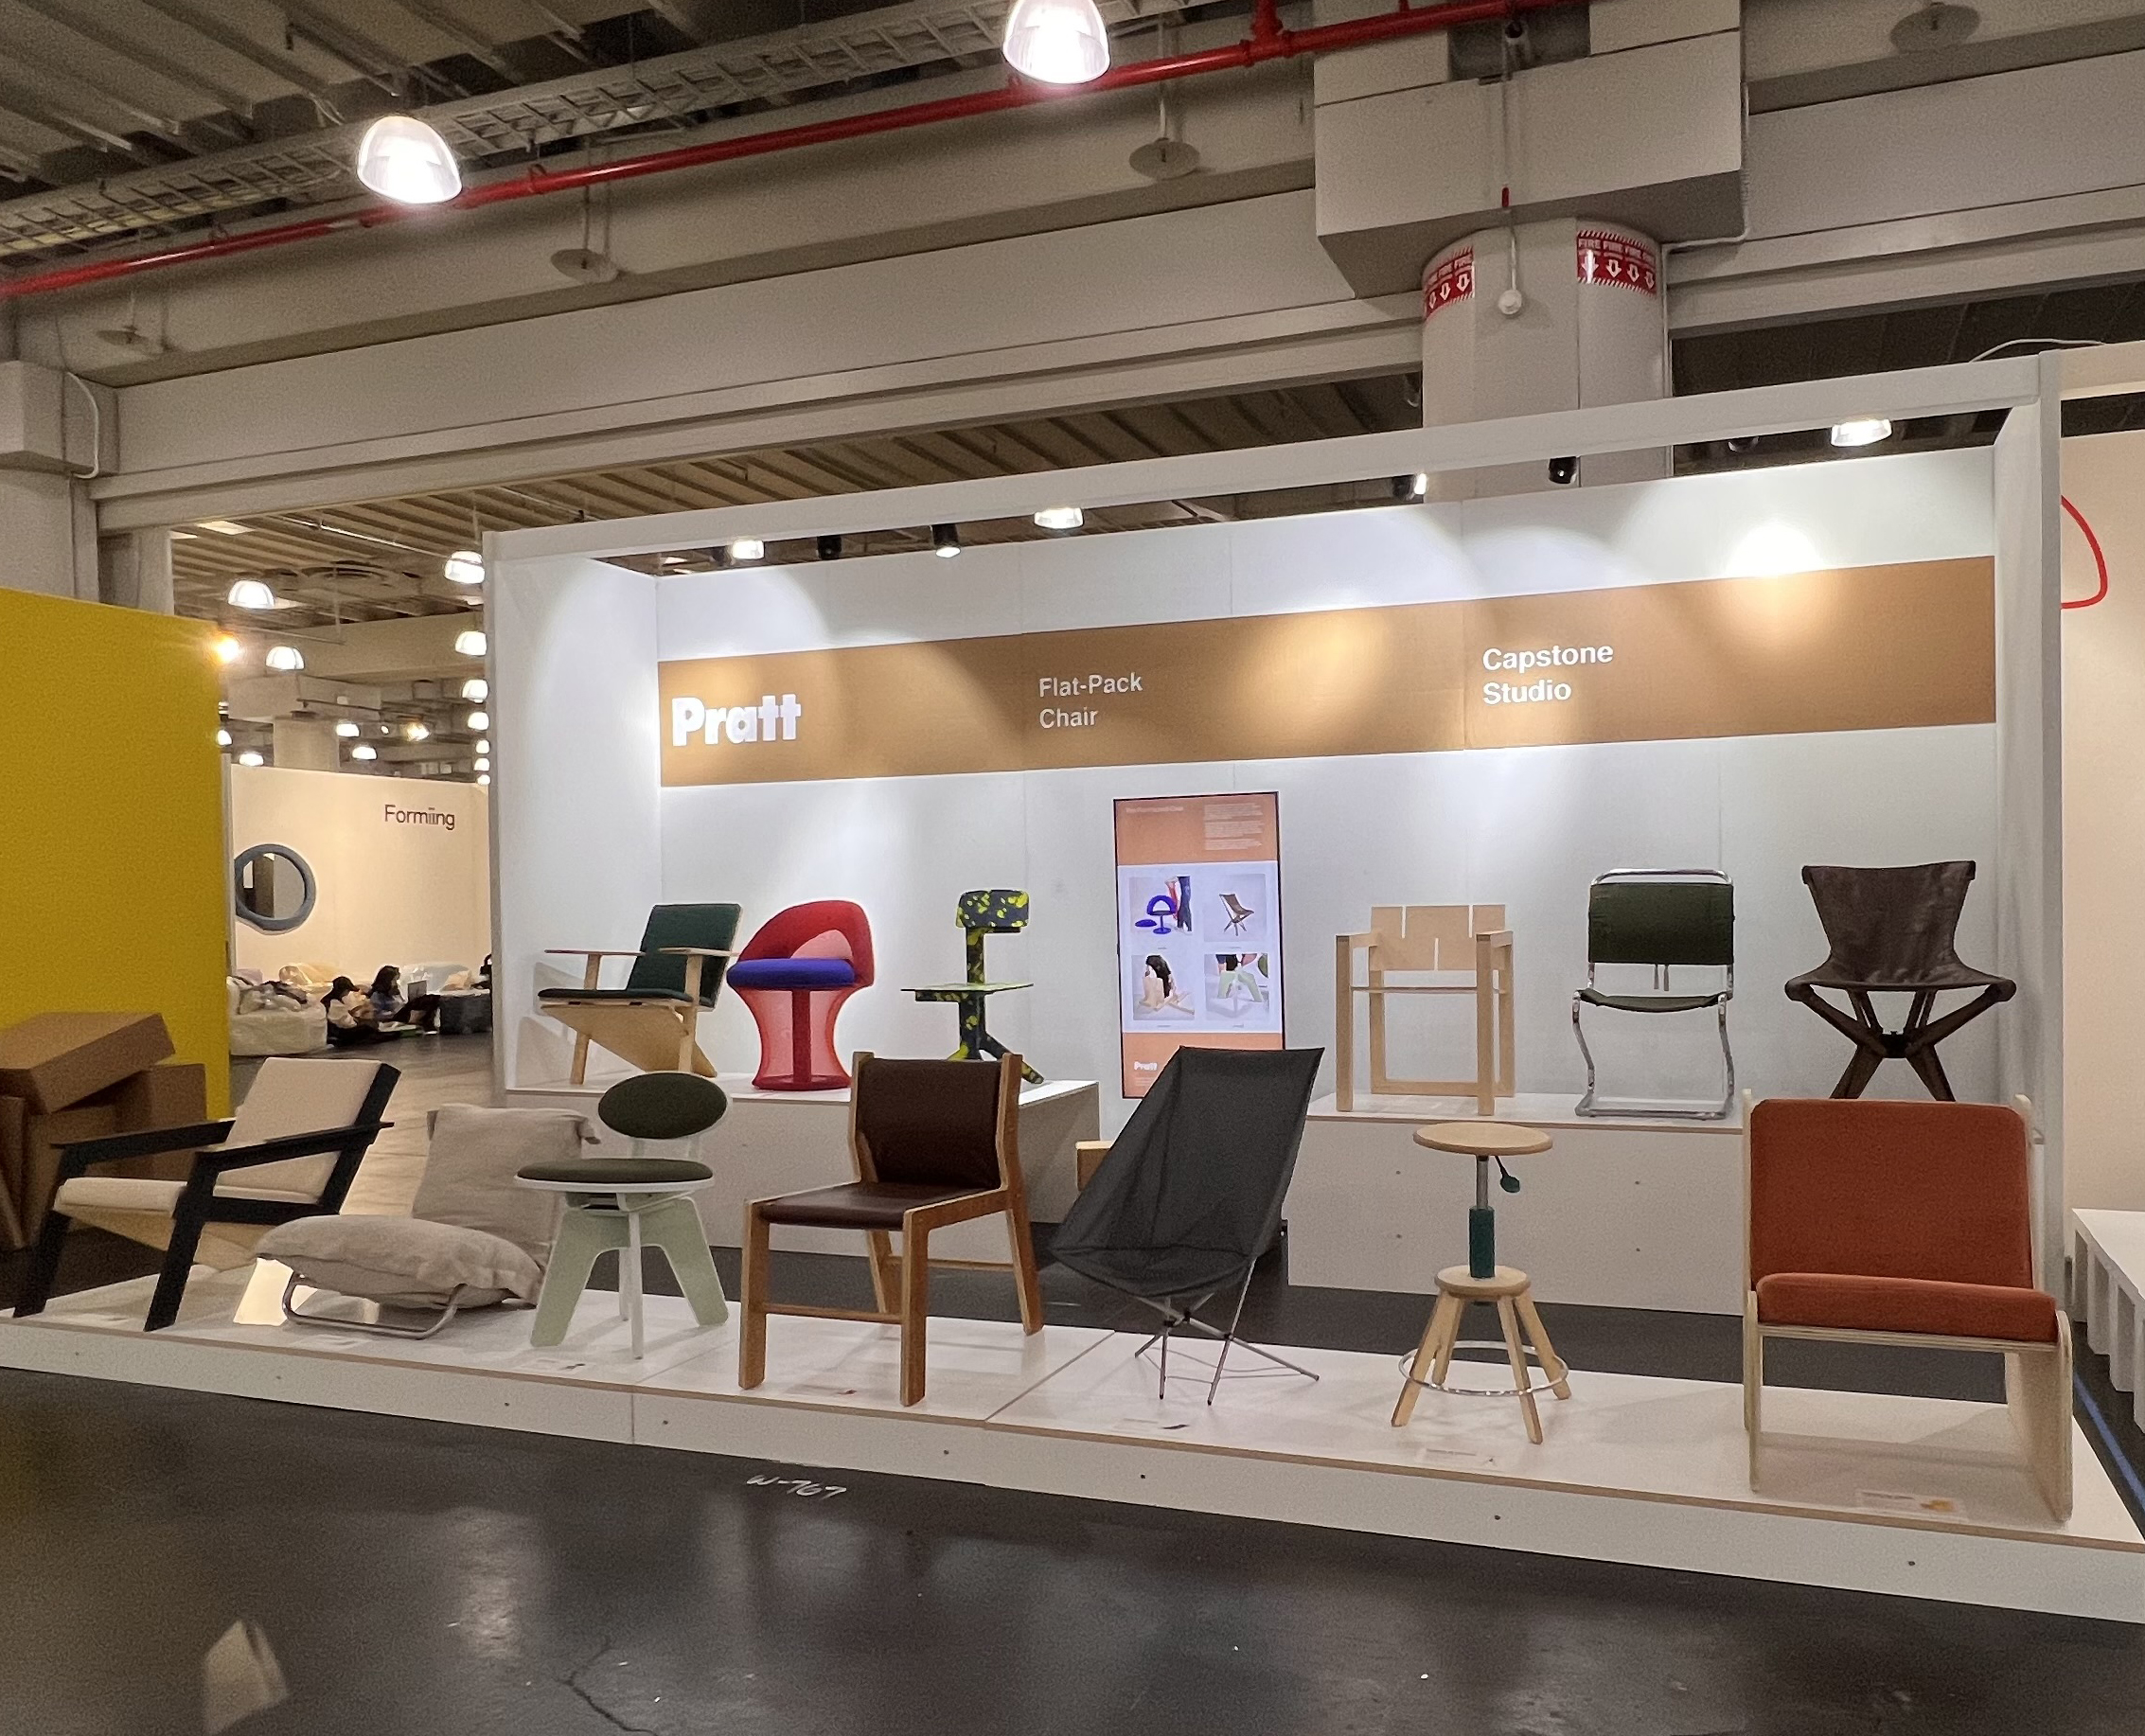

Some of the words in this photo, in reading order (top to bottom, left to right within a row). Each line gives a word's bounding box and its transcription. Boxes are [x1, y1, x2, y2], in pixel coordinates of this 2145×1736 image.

[1578, 239, 1602, 249] FIRE
[1482, 645, 1614, 674] Capstone
[1039, 671, 1143, 698] Flat-Pack
[1482, 679, 1572, 705] Studio
[671, 693, 802, 747] Pratt
[1039, 706, 1099, 729] Chair
